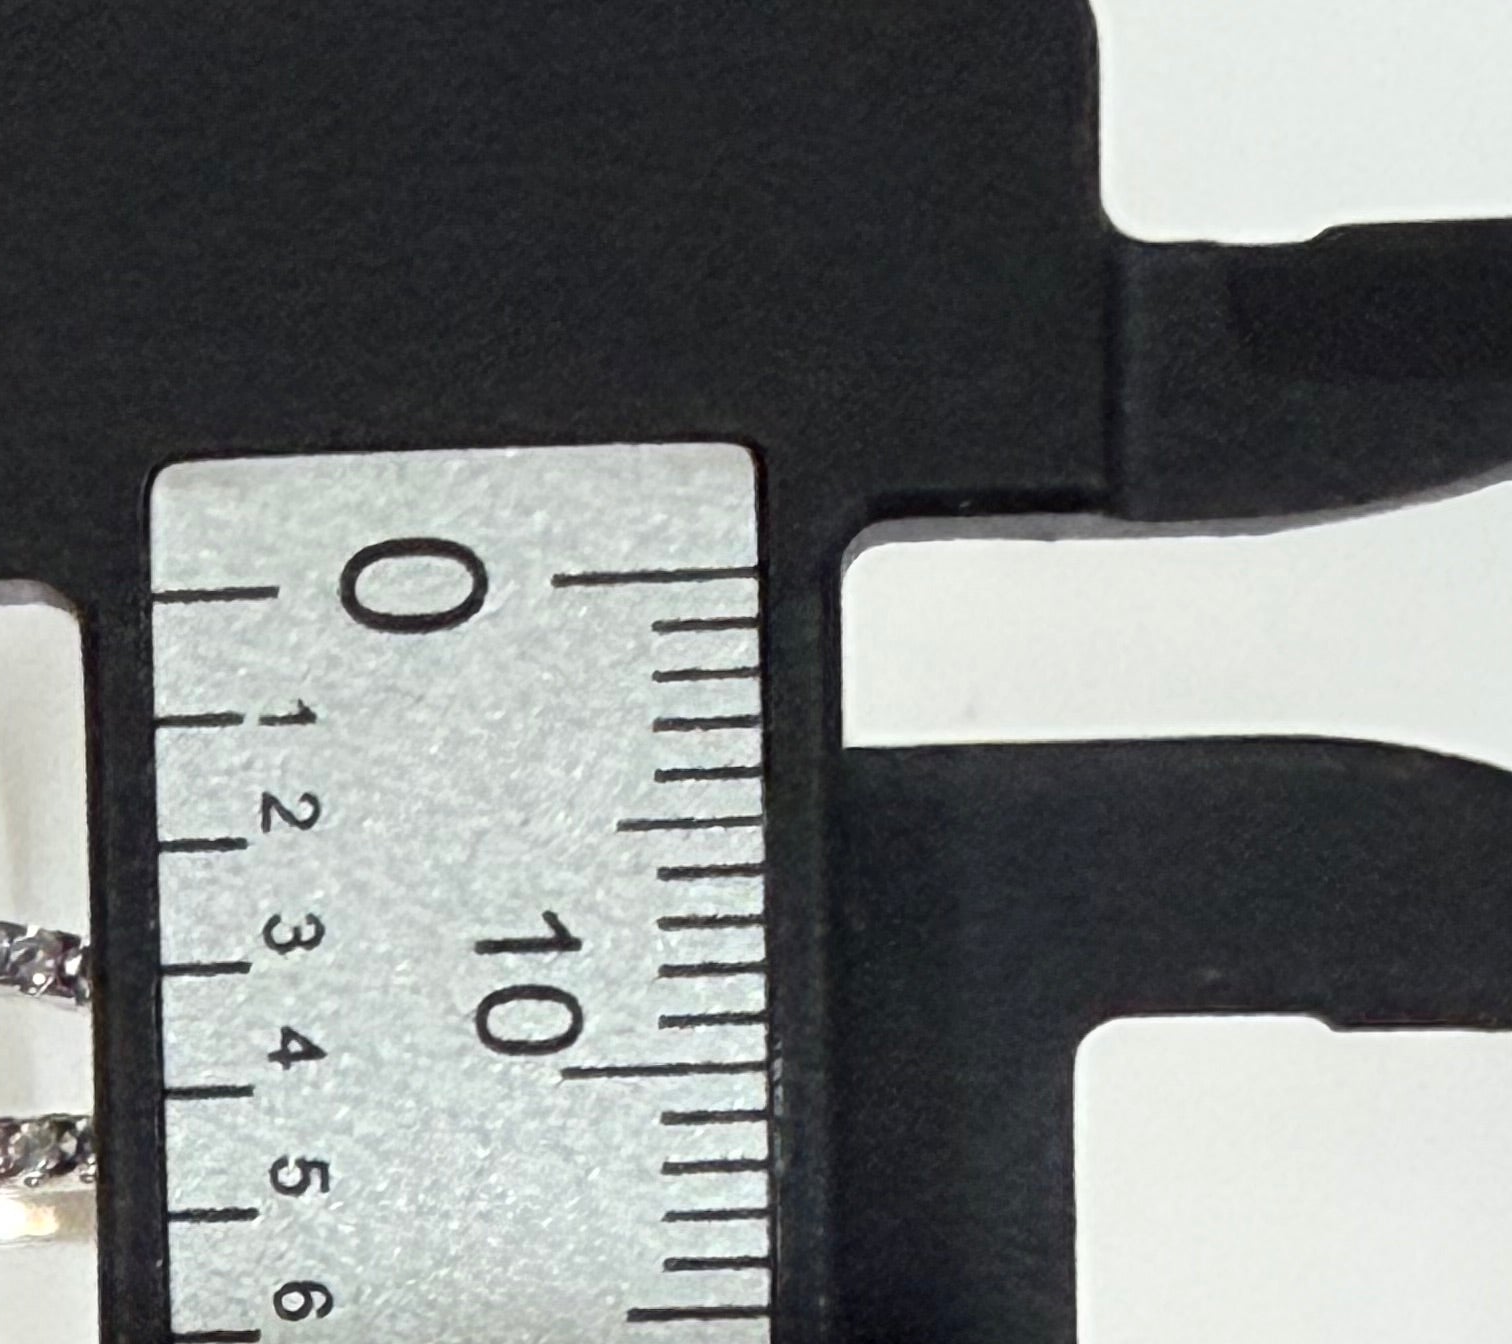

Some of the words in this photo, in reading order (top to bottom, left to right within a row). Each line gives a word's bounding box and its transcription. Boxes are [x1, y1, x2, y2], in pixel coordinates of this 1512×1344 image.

[340, 537, 489, 634] 0
[260, 699, 317, 726] 1
[261, 792, 321, 832] 2
[263, 914, 325, 955] 3
[474, 911, 584, 1056] 10
[268, 1026, 326, 1069] 4
[269, 1157, 329, 1196] 5
[273, 1280, 334, 1322] 6
